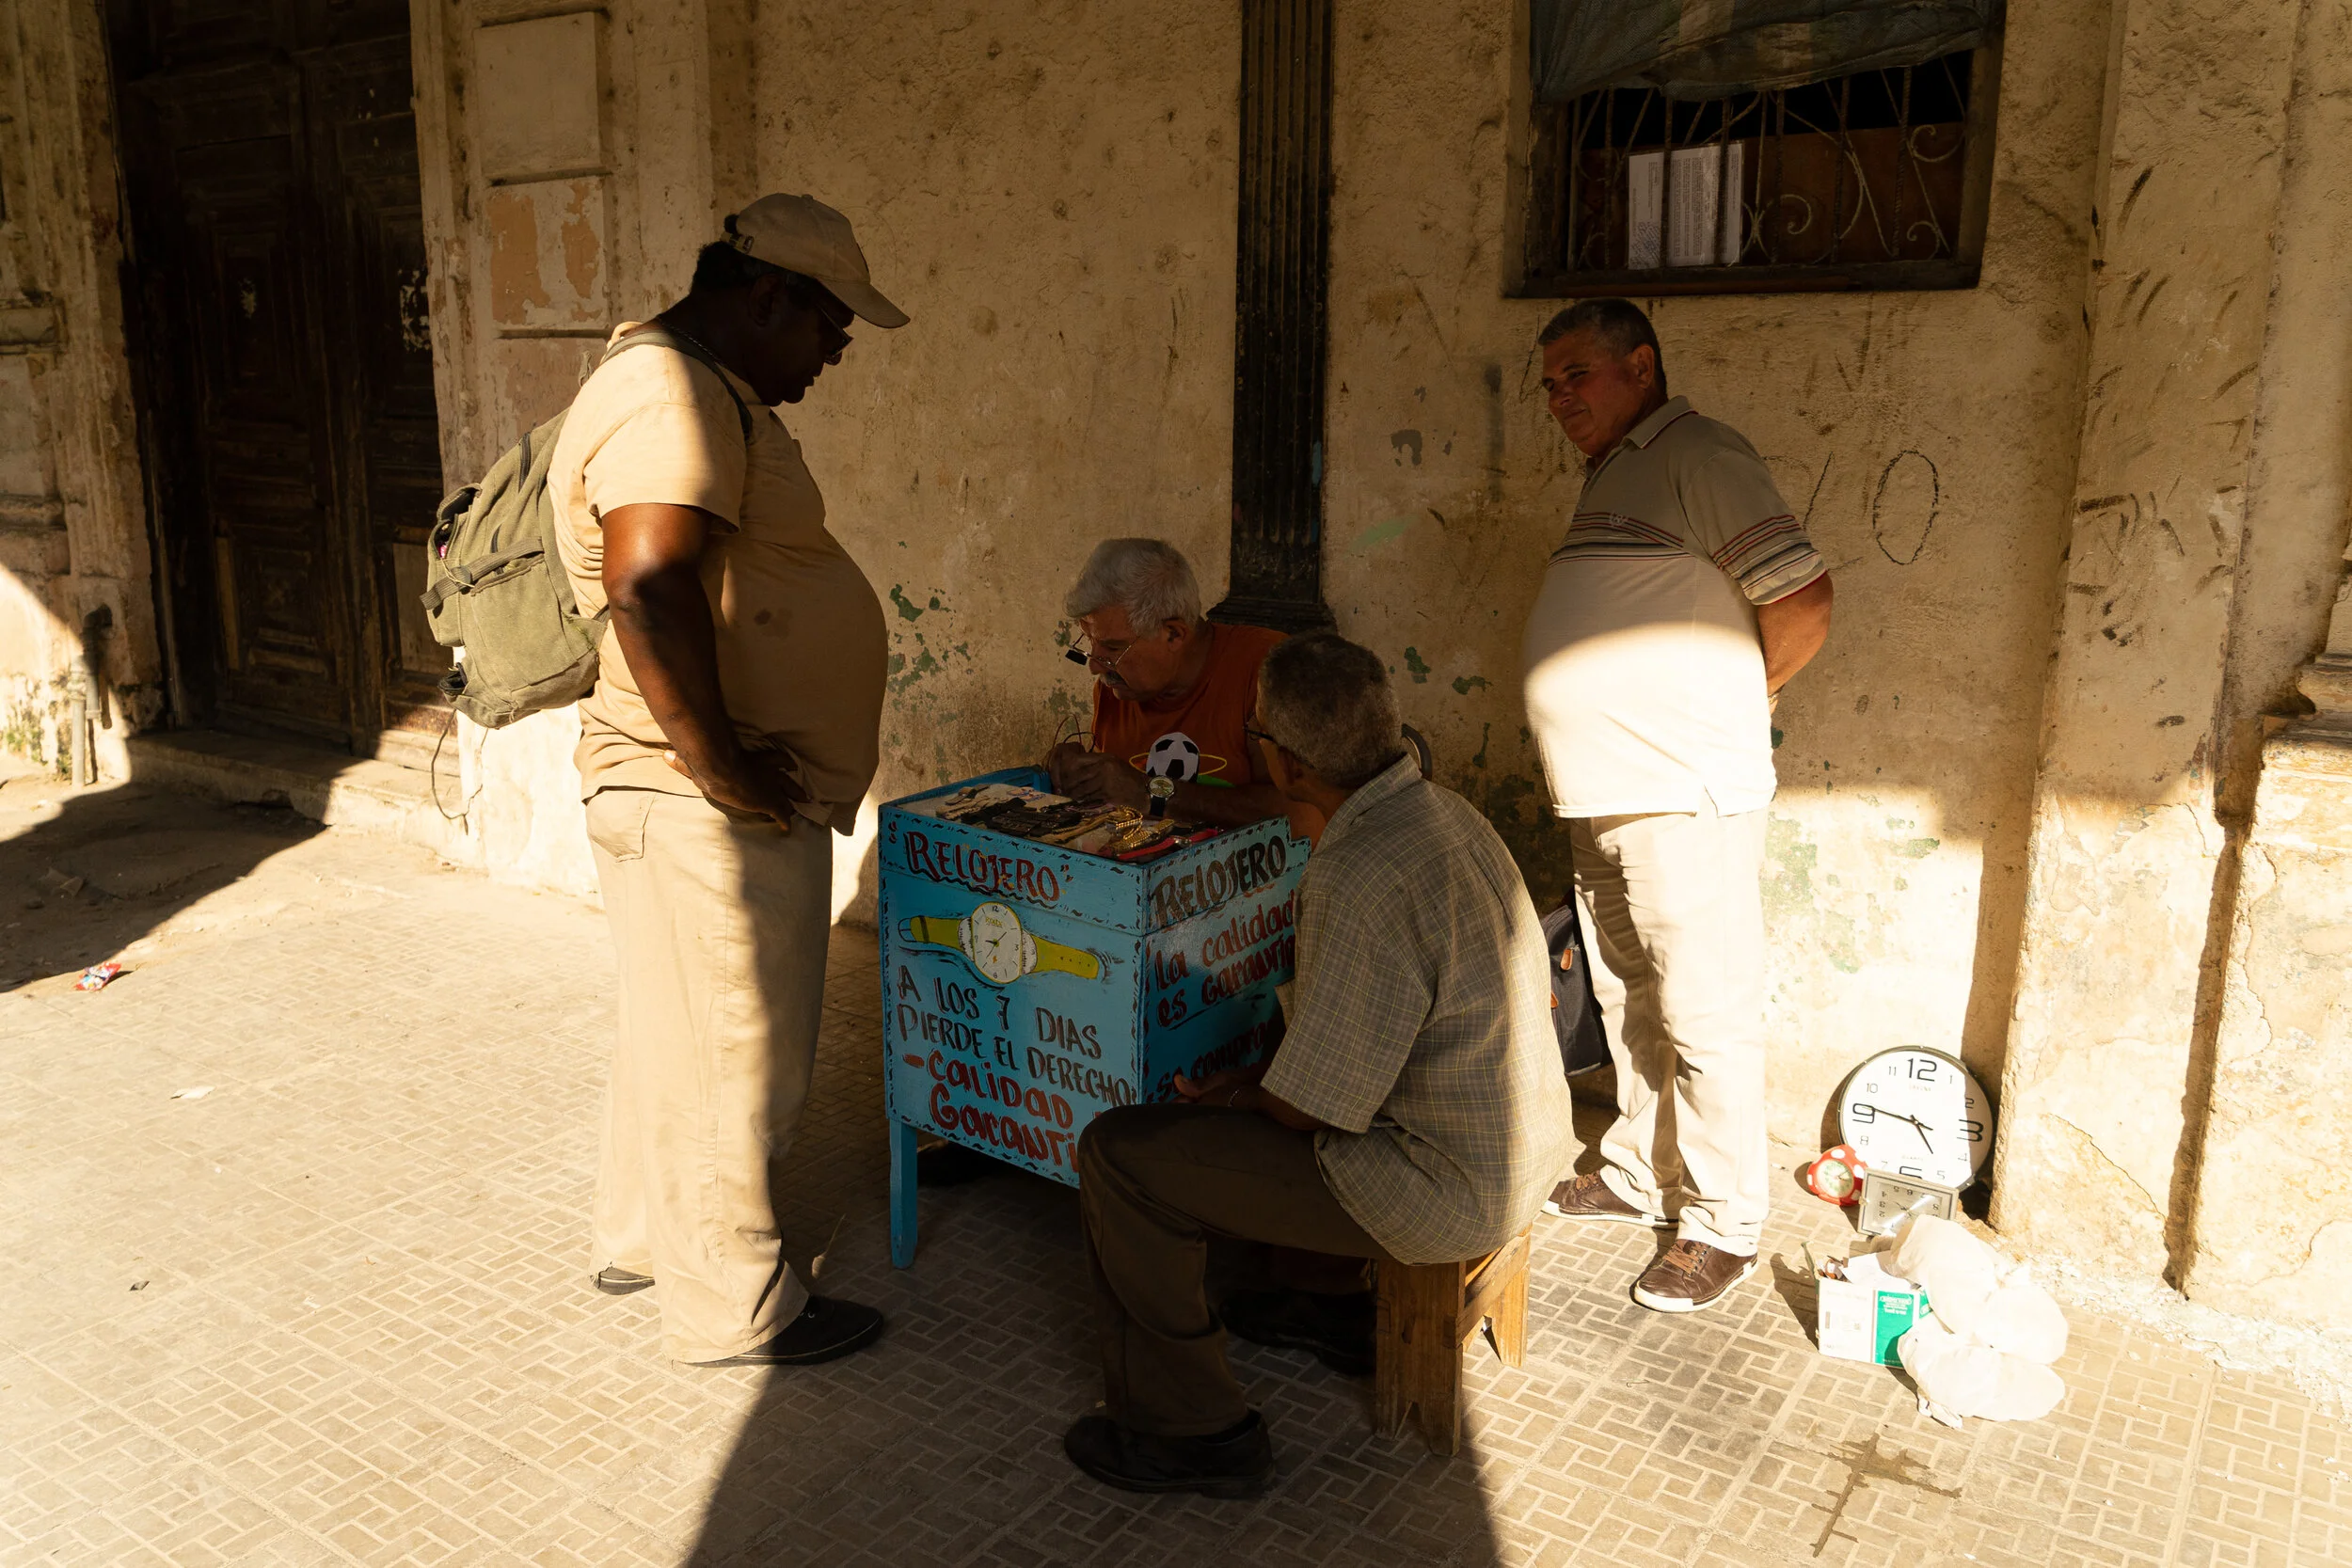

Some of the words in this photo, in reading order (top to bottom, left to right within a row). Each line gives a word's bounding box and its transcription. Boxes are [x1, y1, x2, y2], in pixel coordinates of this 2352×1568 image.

[1149, 835, 1286, 927] RELOJERO
[898, 965, 922, 1002] A
[934, 977, 979, 1019] LOS
[996, 994, 1009, 1031] 7
[1036, 1007, 1102, 1059] DIAS
[897, 1004, 987, 1058] PIERDE
[994, 1037, 1020, 1070] EL
[1026, 1046, 1130, 1107] DERECHO
[1888, 1066, 1897, 1076] 11
[1907, 1057, 1937, 1082] 12
[1867, 1083, 1878, 1094] 10
[1852, 1102, 1876, 1124] 9
[1964, 1097, 1975, 1109] 2
[1957, 1118, 1984, 1142] 3
